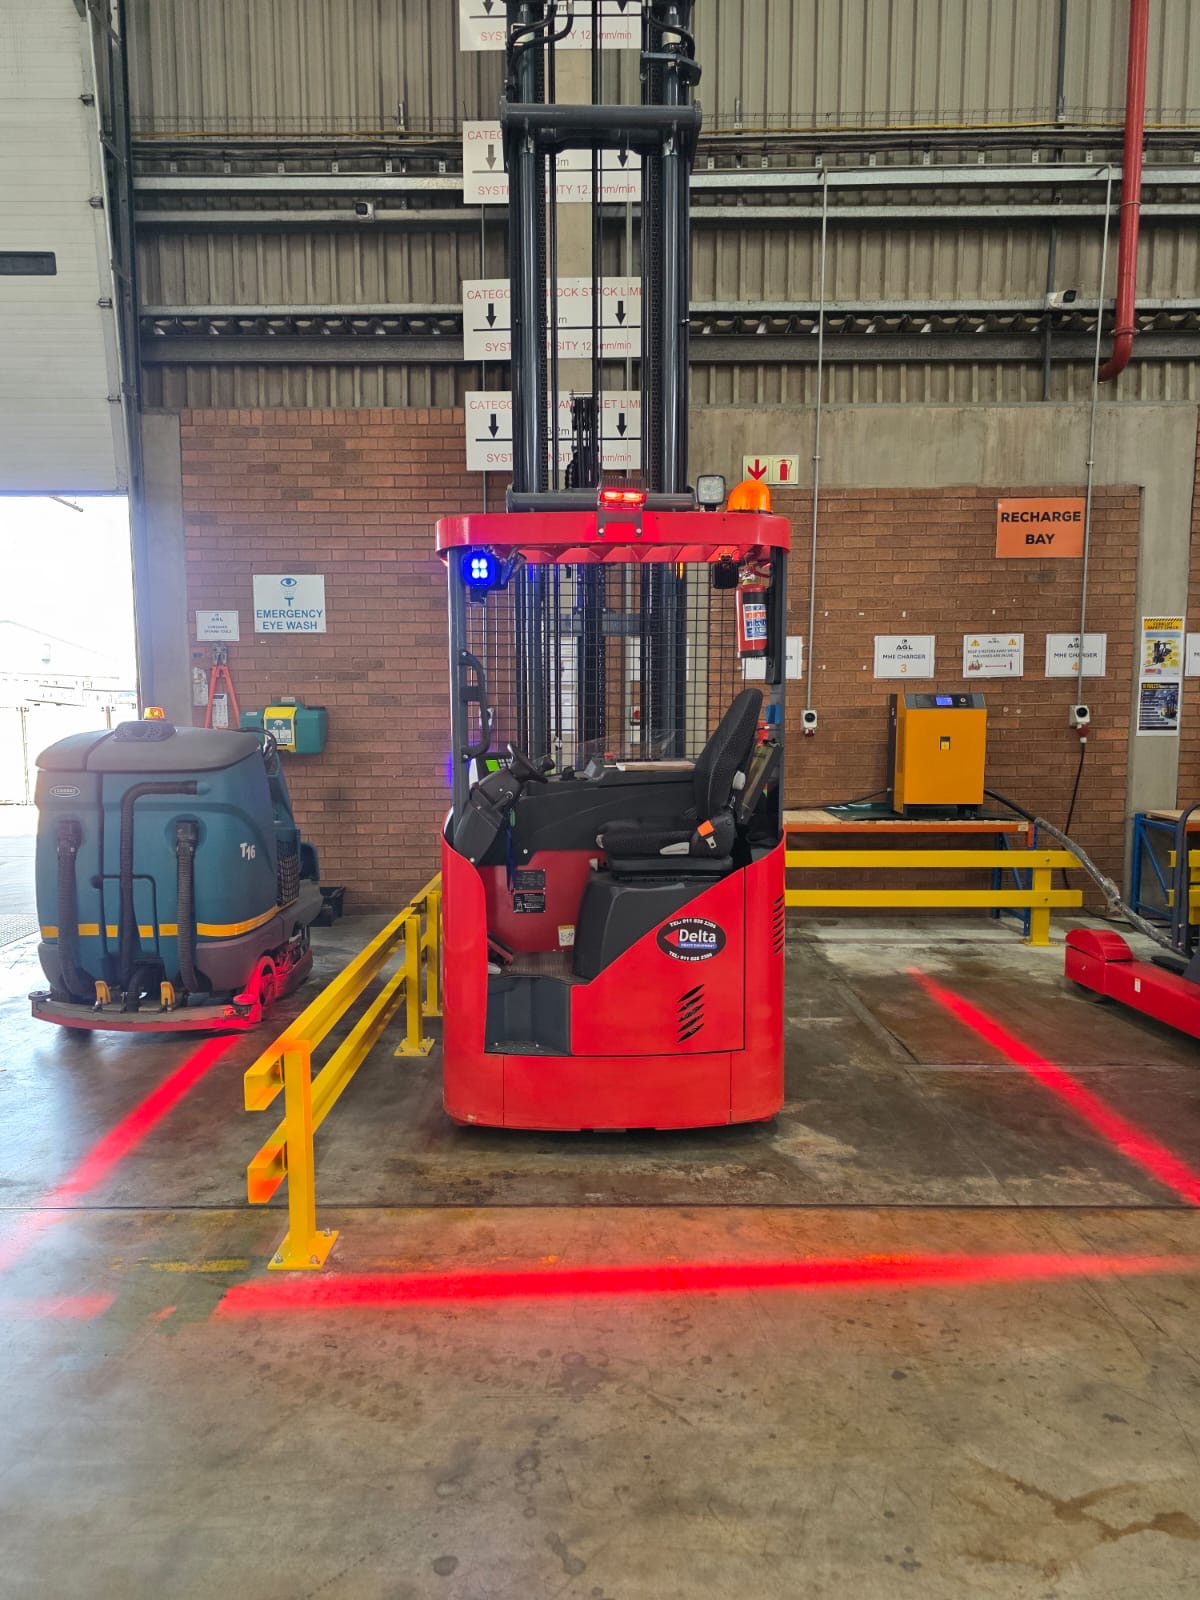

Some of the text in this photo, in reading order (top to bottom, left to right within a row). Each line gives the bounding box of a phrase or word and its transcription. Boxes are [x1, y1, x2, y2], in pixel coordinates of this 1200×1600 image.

[467, 129, 503, 140] CATEG
[478, 185, 509, 196] SYST
[467, 288, 512, 300] CATEGO
[485, 341, 512, 352] SYST
[470, 400, 512, 410] CATEGO
[486, 453, 512, 463] SYST
[1001, 511, 1081, 523] RECHARGE
[1025, 533, 1055, 545] BAY
[256, 609, 323, 619] EMERGENCY
[262, 621, 318, 630] EYE WASH
[900, 663, 907, 673] 3
[240, 842, 256, 860] T16
[679, 929, 716, 943] Delta
